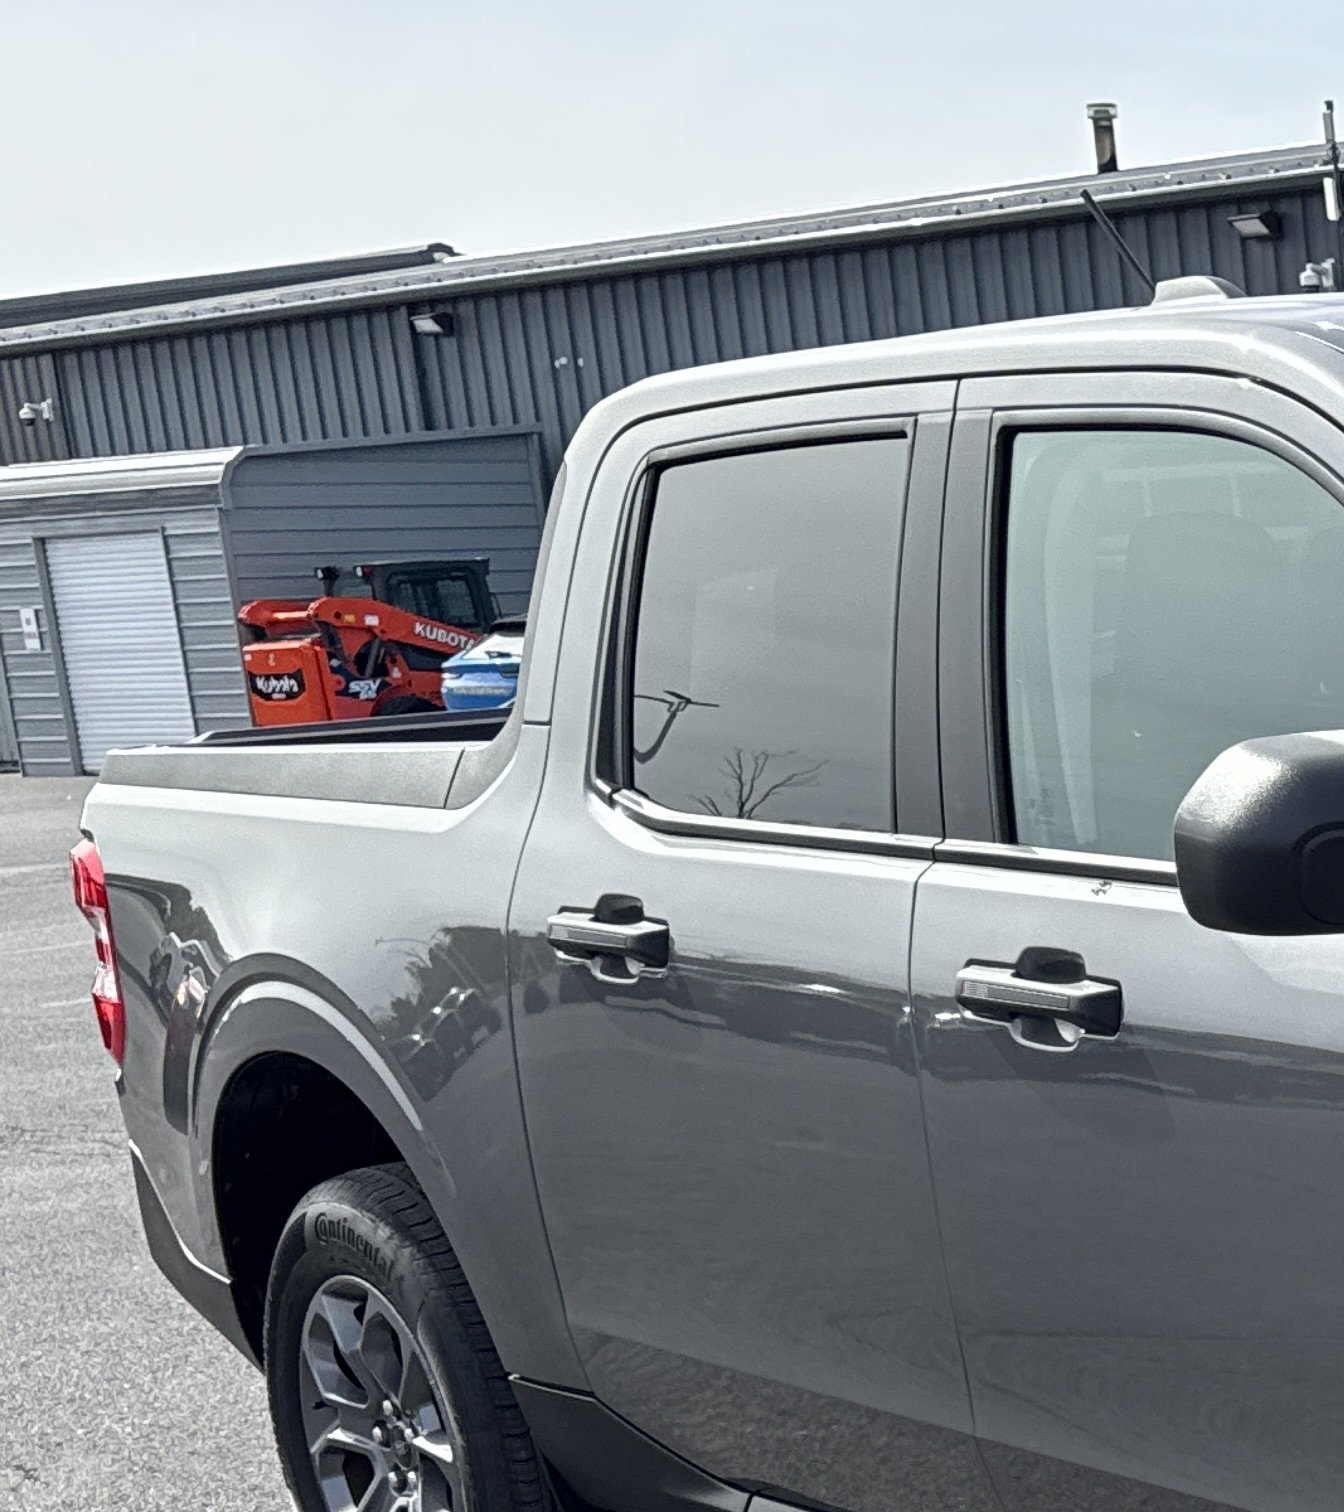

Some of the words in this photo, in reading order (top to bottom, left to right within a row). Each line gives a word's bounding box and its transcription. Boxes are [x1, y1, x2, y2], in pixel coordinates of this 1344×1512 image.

[414, 622, 476, 650] KUBOTA
[255, 675, 299, 693] Kubota
[315, 1212, 395, 1282] Continental
